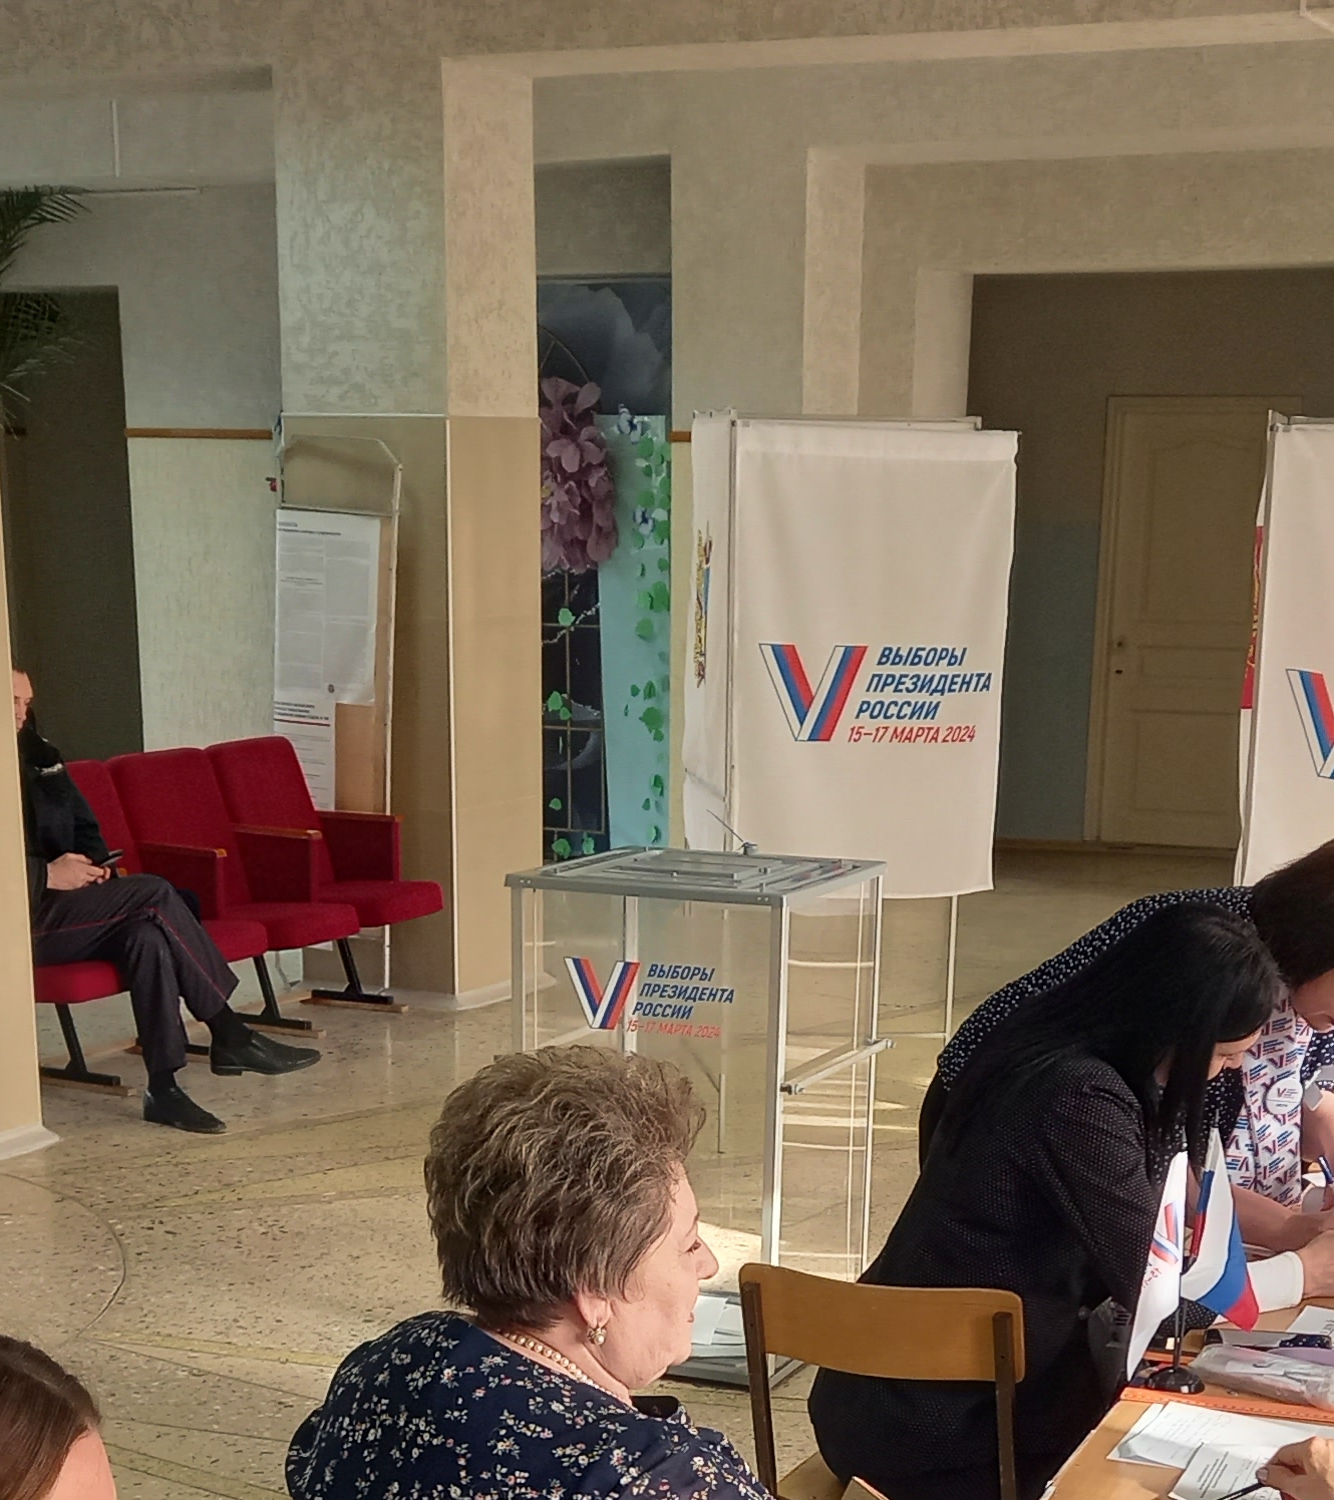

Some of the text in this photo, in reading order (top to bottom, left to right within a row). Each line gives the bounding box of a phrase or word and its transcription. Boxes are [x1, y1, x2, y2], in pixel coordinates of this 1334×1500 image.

[877, 647, 967, 667] ВЫБОРЫ
[865, 672, 992, 695] ПРЕЗИДЕНТА
[855, 700, 941, 720] РОССИИ
[889, 727, 939, 744] МАРТА
[941, 725, 976, 743] 2024
[647, 964, 715, 982] ВЫБОРЫ
[639, 983, 734, 1004] ПРЕЗИДЕНТА
[632, 1002, 693, 1020] РОССИИ
[657, 1023, 693, 1036] МАРТА
[694, 1025, 721, 1039] 2024
